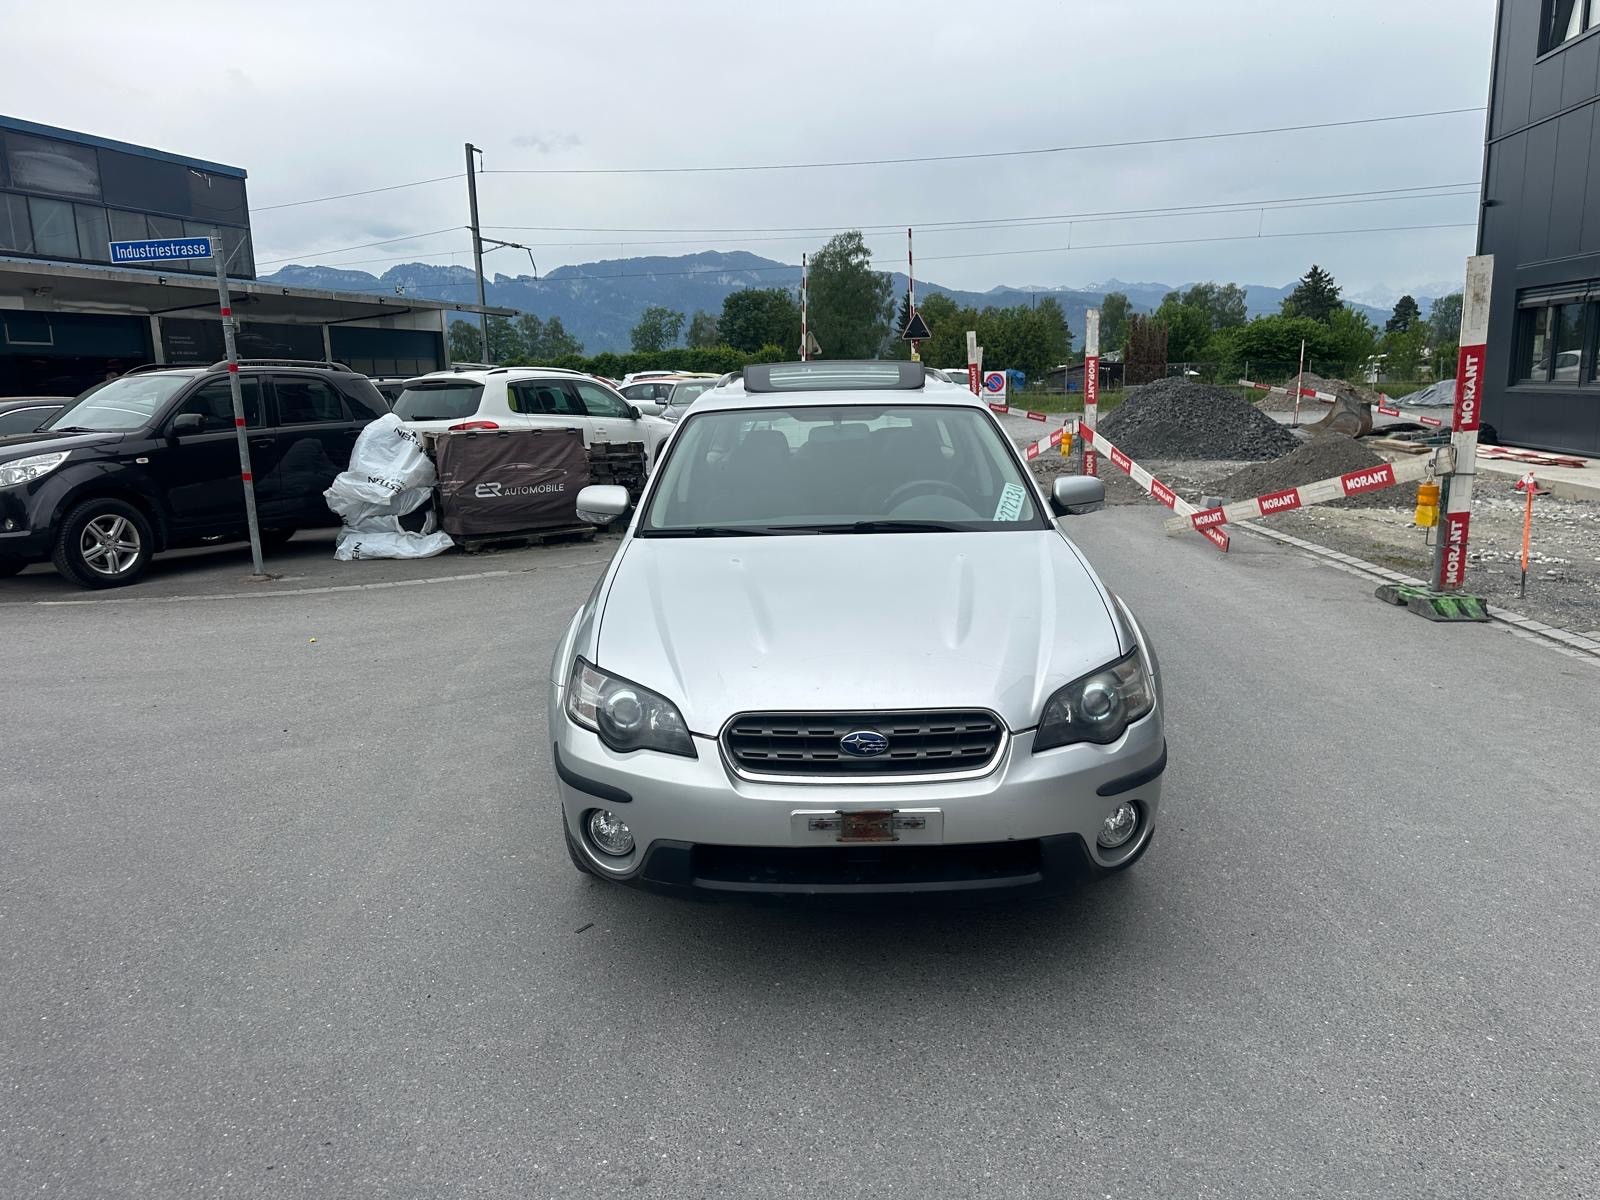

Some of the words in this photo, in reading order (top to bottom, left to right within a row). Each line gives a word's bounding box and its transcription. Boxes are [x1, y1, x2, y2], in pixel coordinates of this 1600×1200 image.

[116, 243, 206, 259] Industriestrasse
[1088, 359, 1096, 400] MORANT
[1461, 354, 1478, 425] MORANT
[1112, 452, 1130, 470] MORANT
[504, 483, 565, 496] AUTOMOBILE
[1346, 470, 1388, 490] MORANT
[1153, 485, 1174, 505] MORANT
[1262, 494, 1295, 511] MORANT
[1195, 512, 1222, 526] MORANT
[1446, 520, 1463, 584] MORANT
